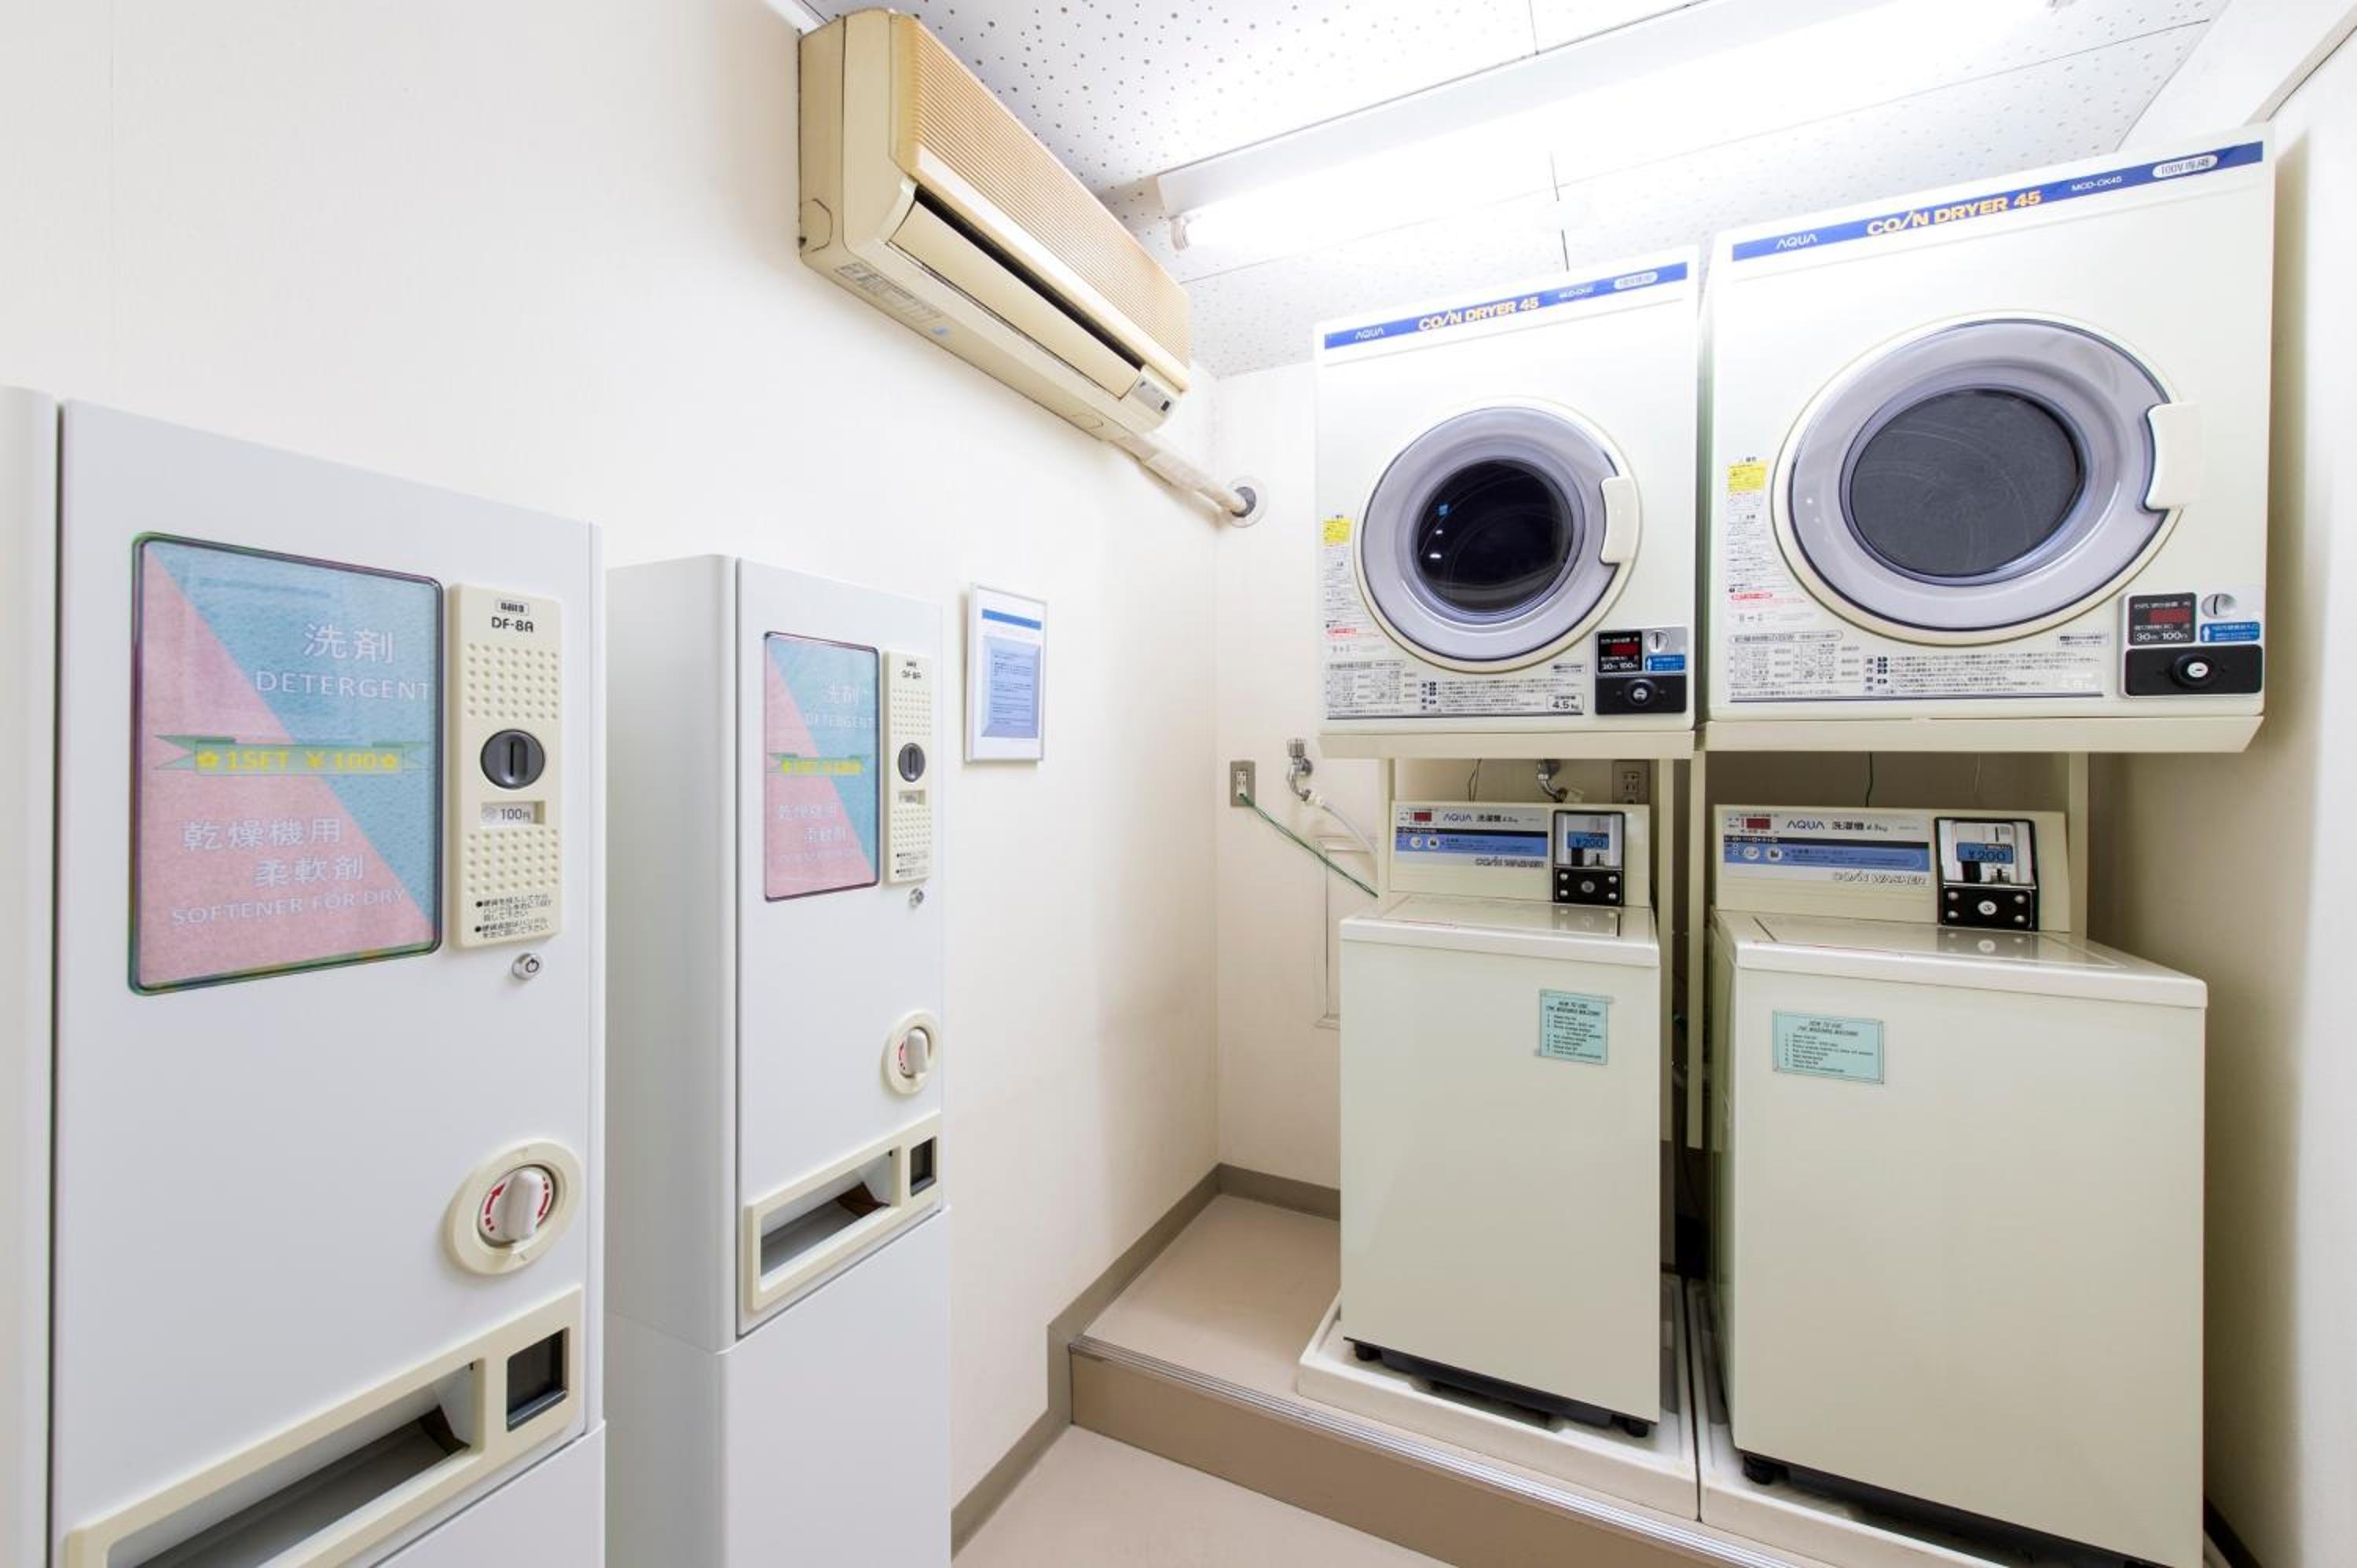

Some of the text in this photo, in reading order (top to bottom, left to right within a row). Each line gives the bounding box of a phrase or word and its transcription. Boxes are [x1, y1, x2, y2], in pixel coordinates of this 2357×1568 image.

[1934, 197, 2008, 224] DRYER
[2014, 190, 2041, 207] 45
[1776, 233, 1816, 249] AQUA
[1465, 301, 1517, 321] DRYER
[1519, 296, 1540, 310] 45
[491, 617, 533, 632] DF-8A
[303, 623, 393, 664] 洗剤
[255, 670, 430, 701] DETERGENT
[181, 817, 341, 852] 乾燥機用
[1787, 819, 1825, 830] AQUA
[254, 855, 365, 887] 柔軟剤
[171, 898, 303, 926] SOFTENER
[364, 888, 405, 907] DRY
